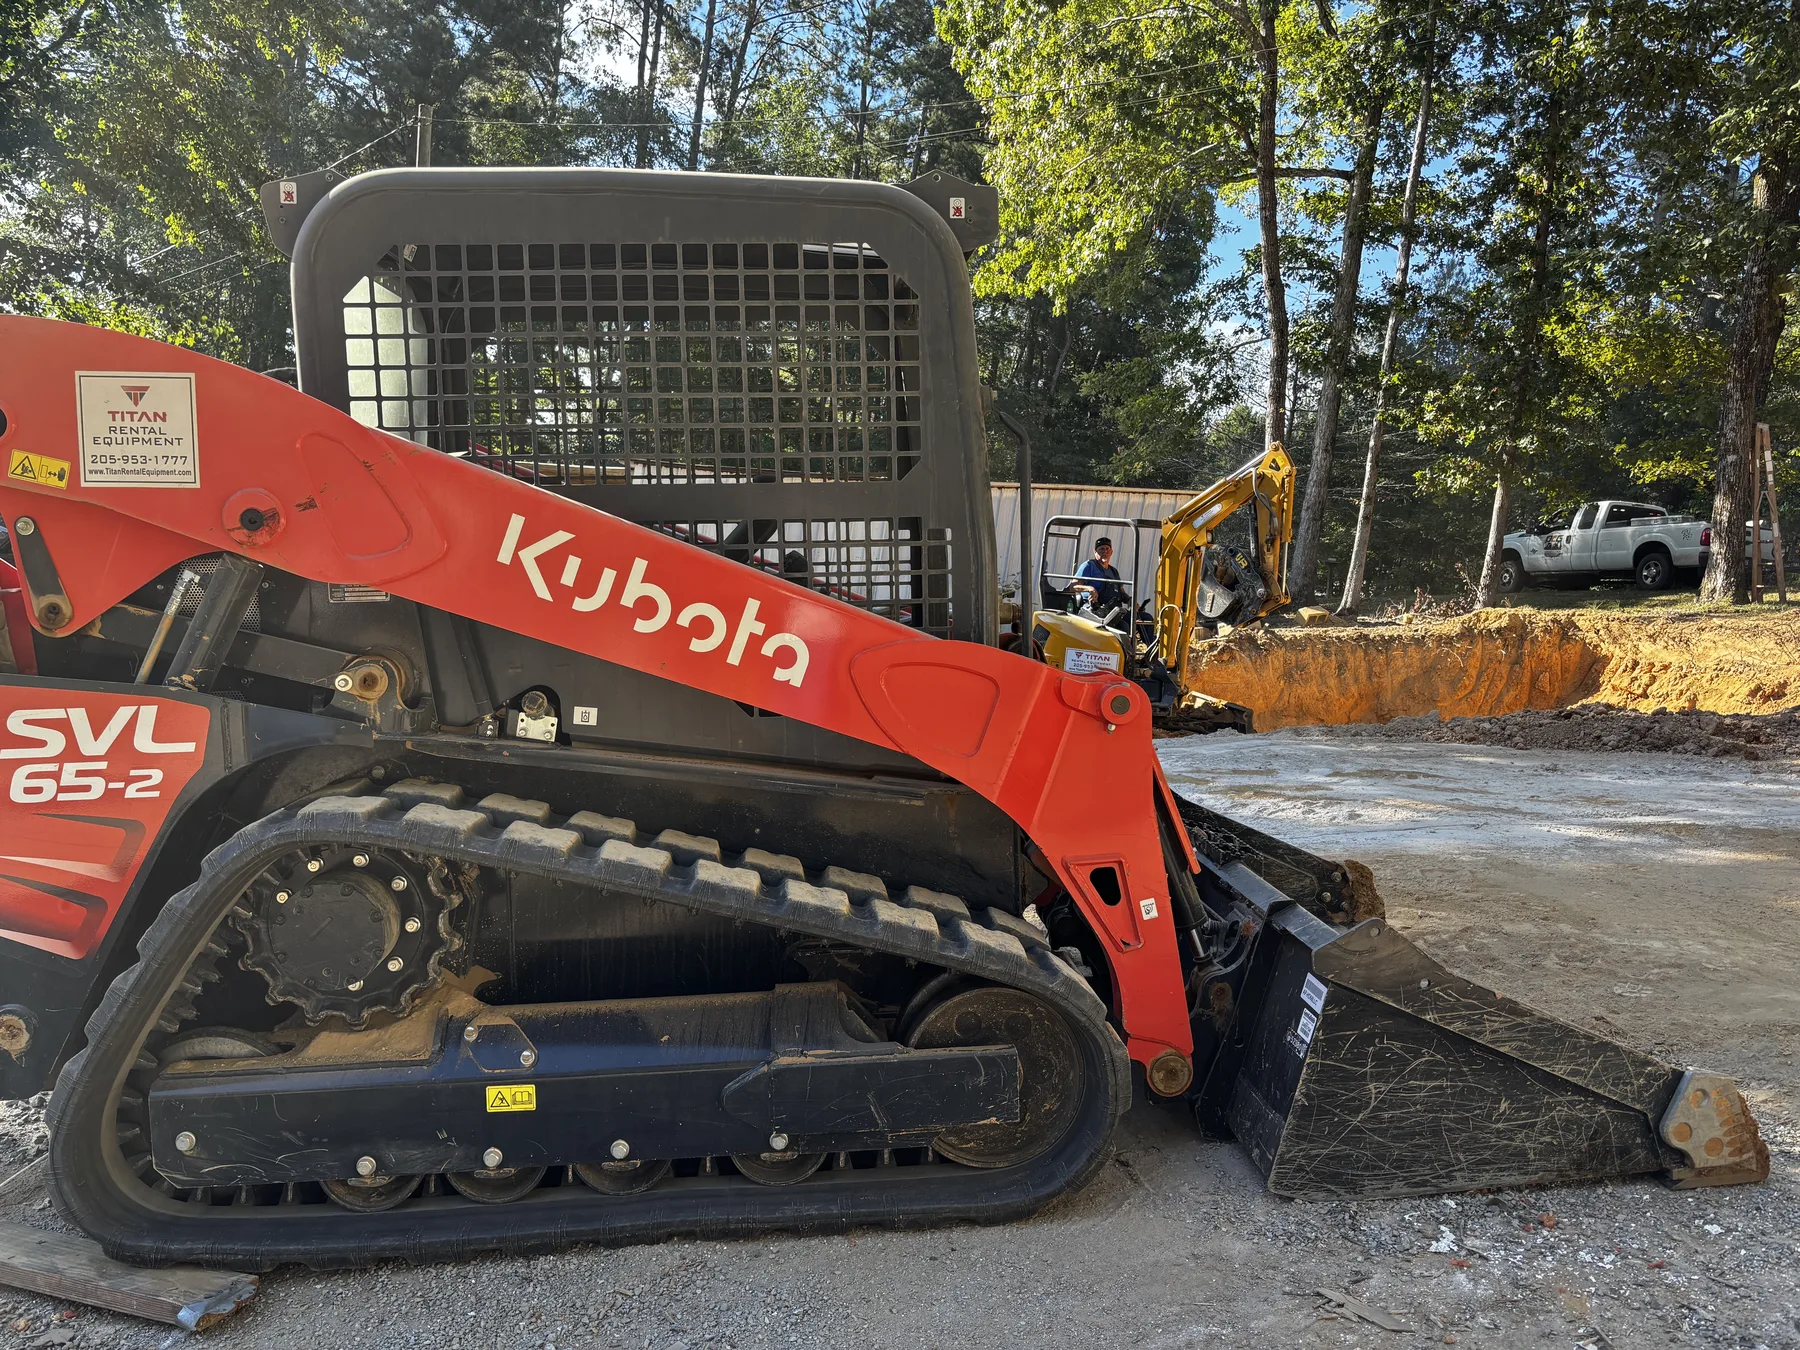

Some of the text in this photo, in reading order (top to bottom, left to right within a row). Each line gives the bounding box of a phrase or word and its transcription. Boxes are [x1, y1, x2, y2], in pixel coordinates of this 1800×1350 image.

[107, 411, 167, 422] TITAN
[108, 426, 167, 435] RENTAL
[93, 436, 183, 447] EQUIPMENT
[91, 455, 188, 465] 205-953-1777
[88, 468, 192, 477] www.TitanRentalEquipment.com
[497, 513, 809, 688] Kubota
[0, 705, 196, 759] SVL
[9, 761, 164, 803] 65-2
